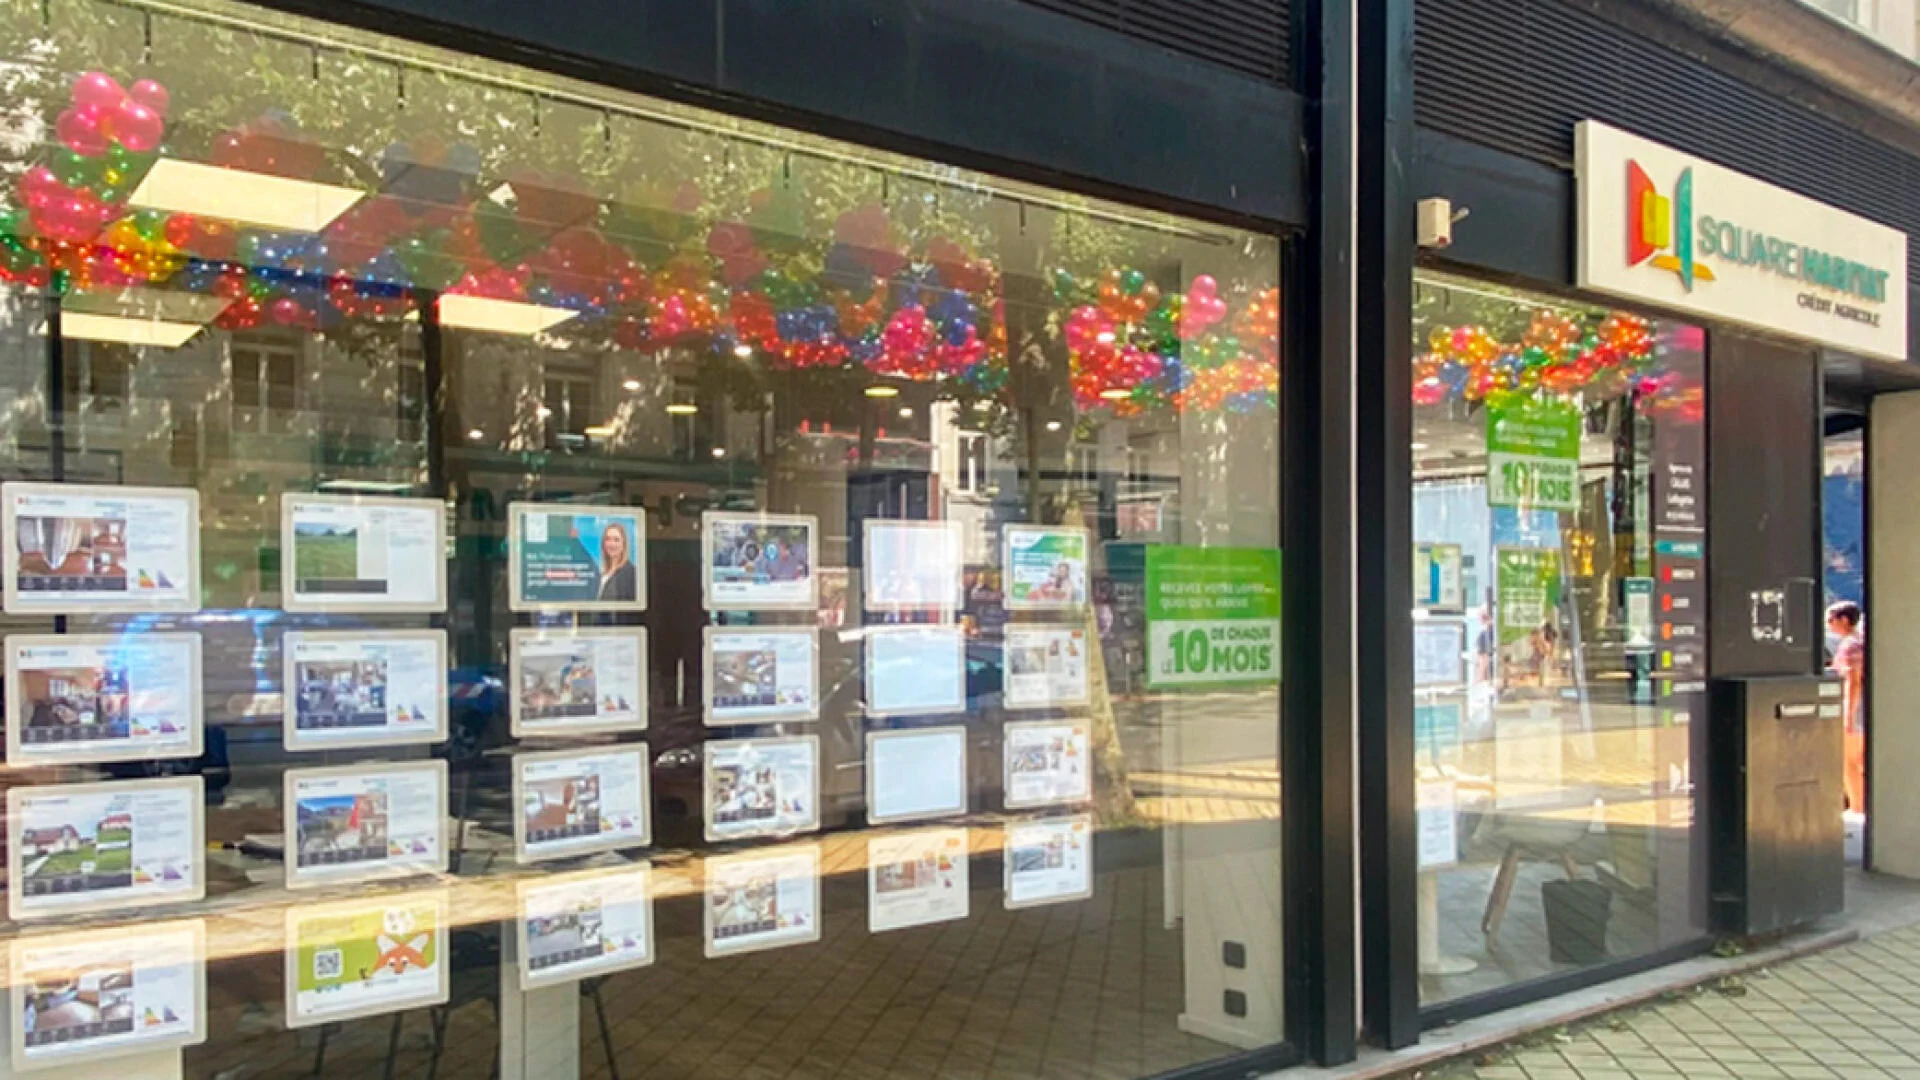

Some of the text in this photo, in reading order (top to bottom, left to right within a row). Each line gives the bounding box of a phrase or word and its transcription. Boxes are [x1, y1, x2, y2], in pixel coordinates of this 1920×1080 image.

[1697, 215, 1889, 304] SQUARE HABITAT
[1834, 303, 1880, 328] AGRICOLE
[1502, 461, 1529, 497] 10
[1168, 627, 1209, 674] 10
[1211, 643, 1273, 673] MOIS
[1210, 626, 1271, 642] DE CHAQUE
